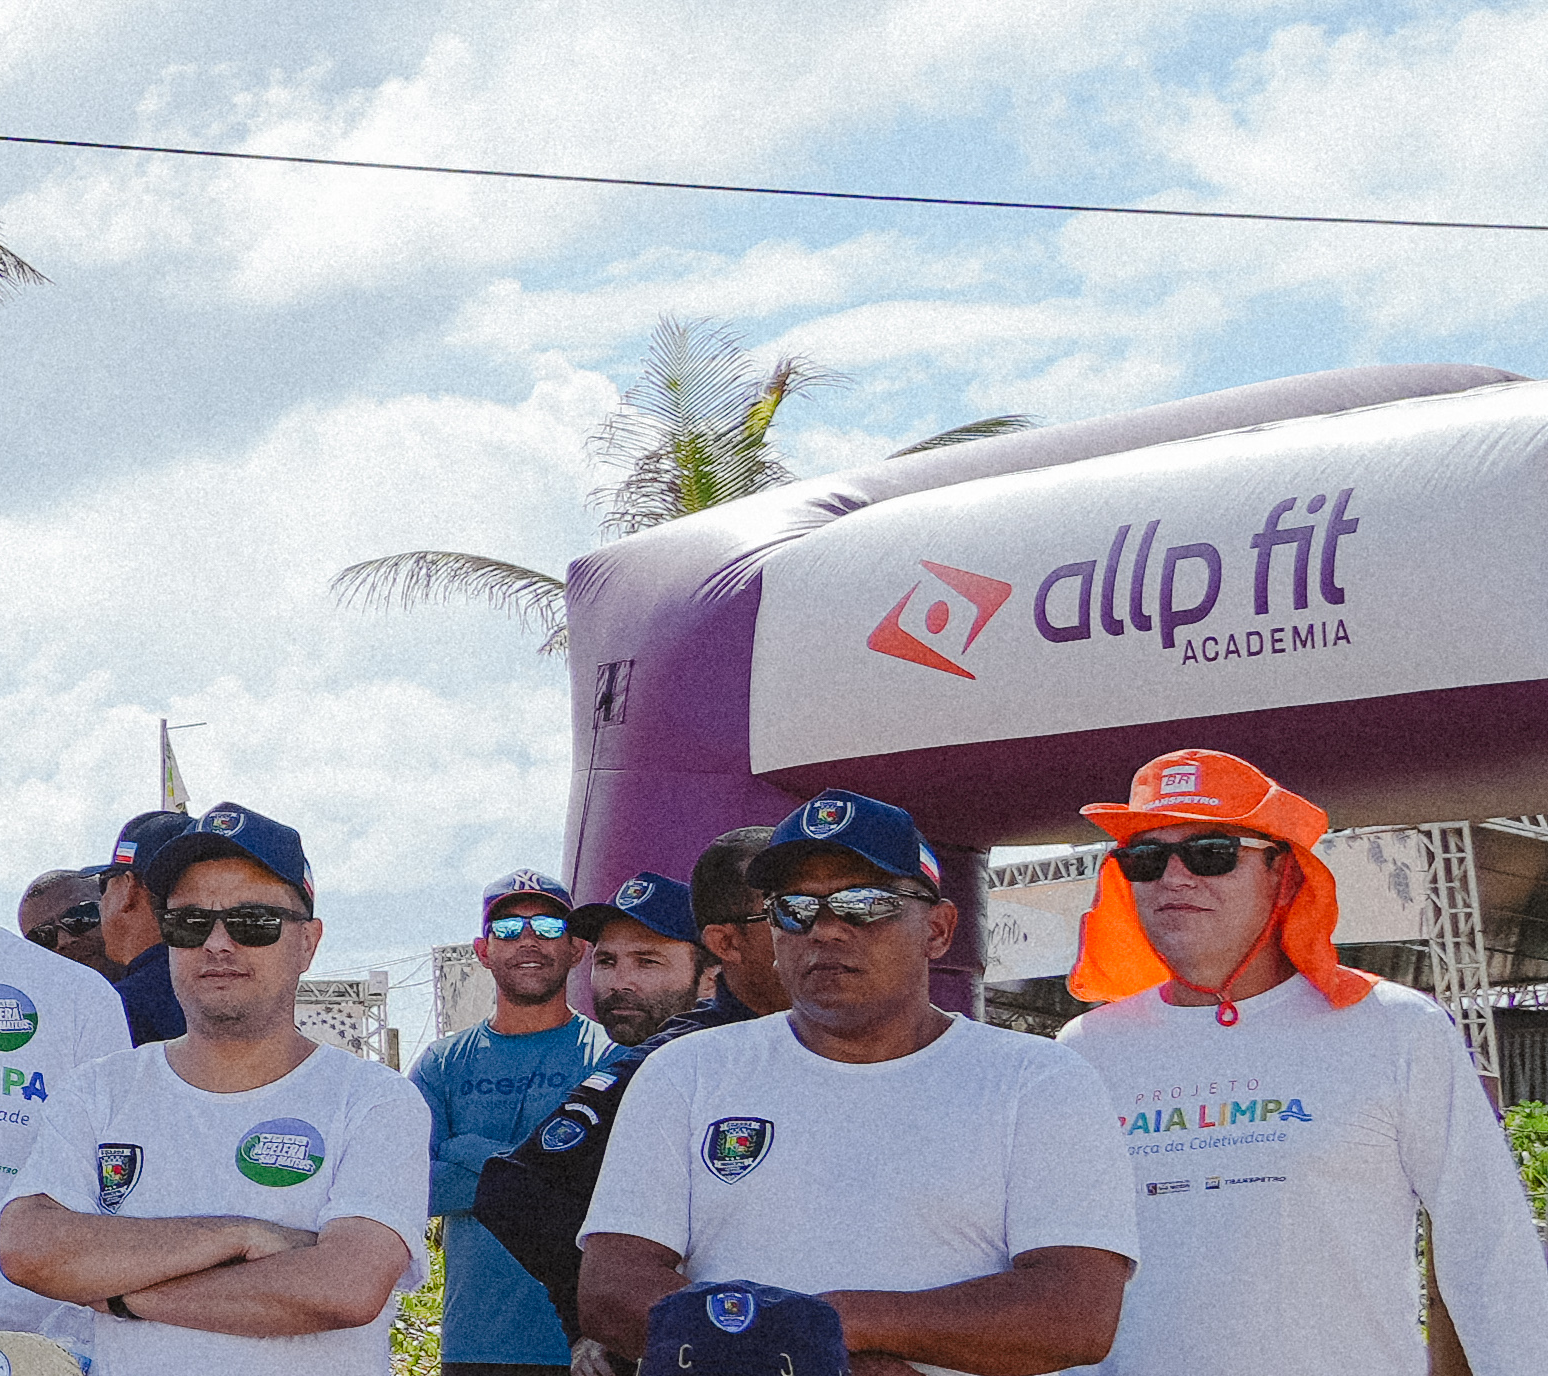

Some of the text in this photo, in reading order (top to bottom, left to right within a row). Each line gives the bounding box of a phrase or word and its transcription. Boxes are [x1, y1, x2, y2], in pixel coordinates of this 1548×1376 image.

[1033, 487, 1359, 648] allp fit
[1181, 618, 1352, 665] ACADEMIA
[1134, 1078, 1260, 1105] PROJETO
[1199, 1097, 1313, 1129] LIMPA
[1164, 1139, 1185, 1154] da
[1189, 1130, 1287, 1151] Coletividade
